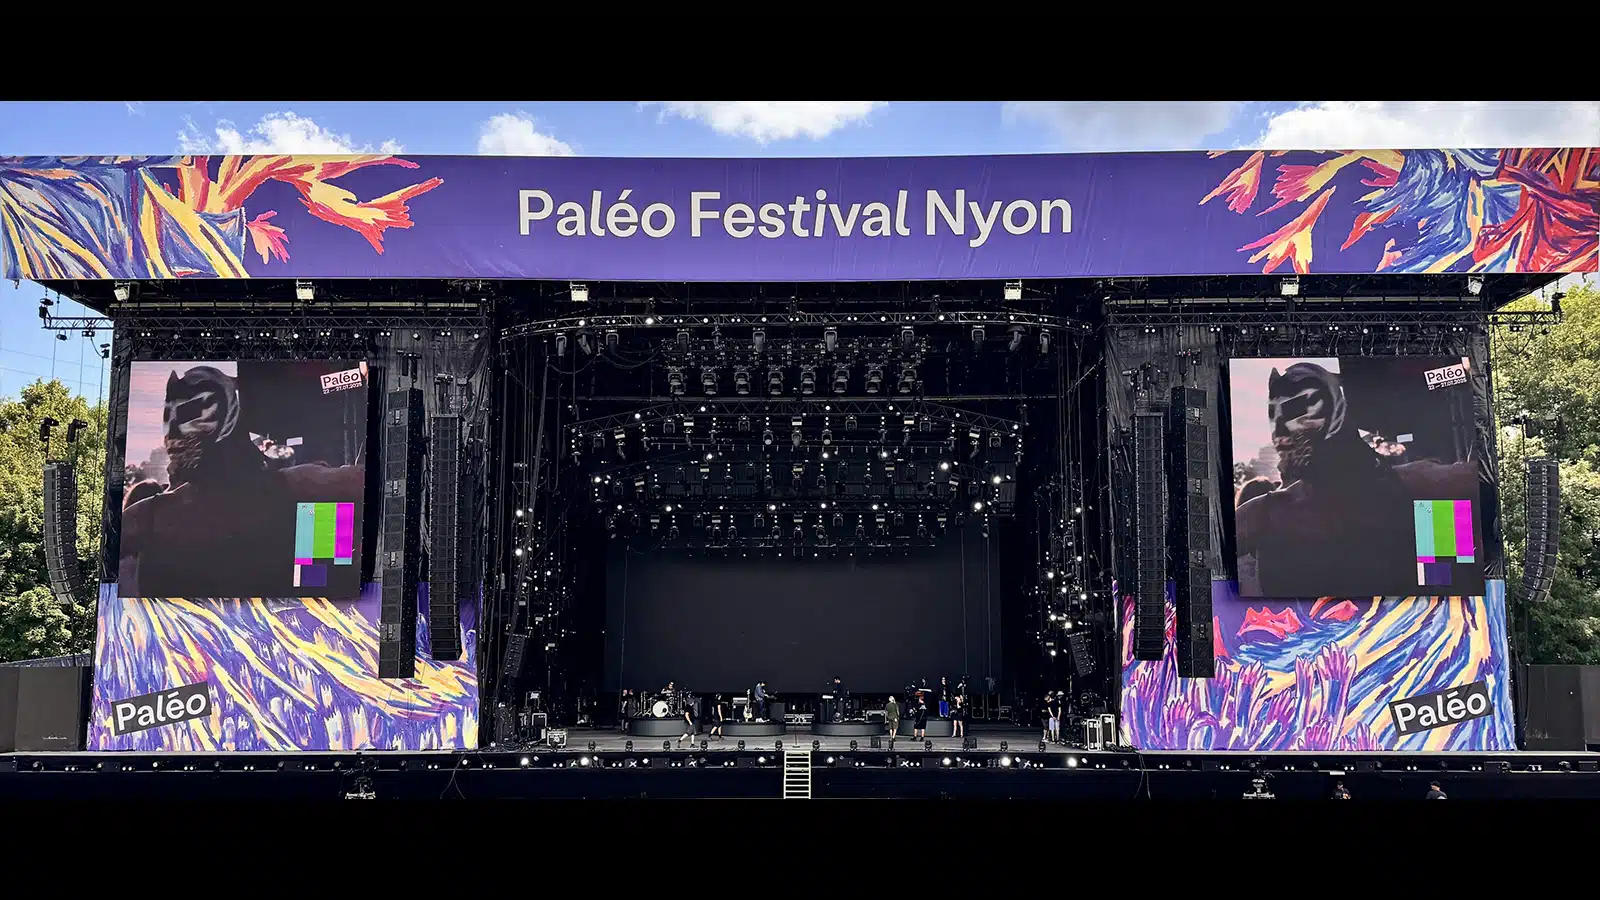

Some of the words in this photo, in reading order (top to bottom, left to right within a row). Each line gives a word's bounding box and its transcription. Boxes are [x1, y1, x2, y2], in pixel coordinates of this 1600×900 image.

[519, 189, 675, 238] Paléo
[691, 189, 910, 239] Festival
[926, 189, 1072, 248] Nyon
[322, 372, 359, 387] Paléo
[1426, 368, 1463, 383] Paléo
[116, 691, 207, 731] Paléo
[1394, 691, 1487, 732] Paléo
